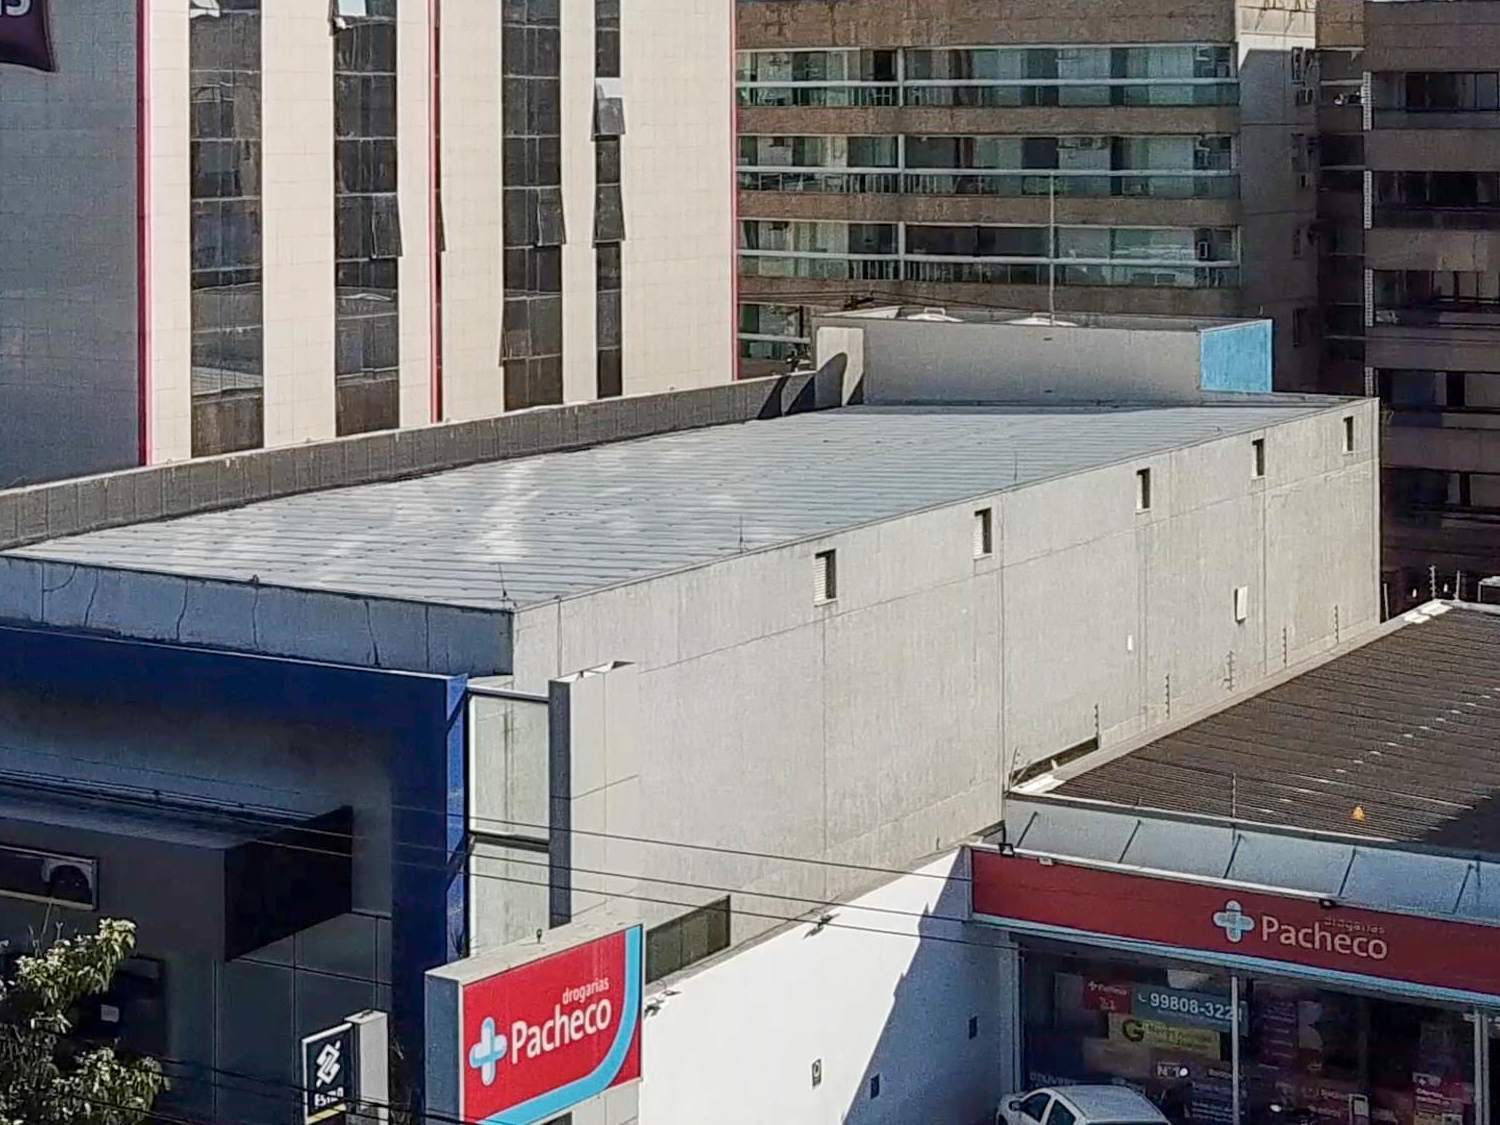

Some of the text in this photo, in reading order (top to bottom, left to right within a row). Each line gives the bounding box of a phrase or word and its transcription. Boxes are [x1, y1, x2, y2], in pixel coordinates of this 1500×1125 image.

[1261, 915, 1388, 960] Pacheco
[562, 976, 610, 1005] drogarias
[511, 998, 612, 1065] Pacheco
